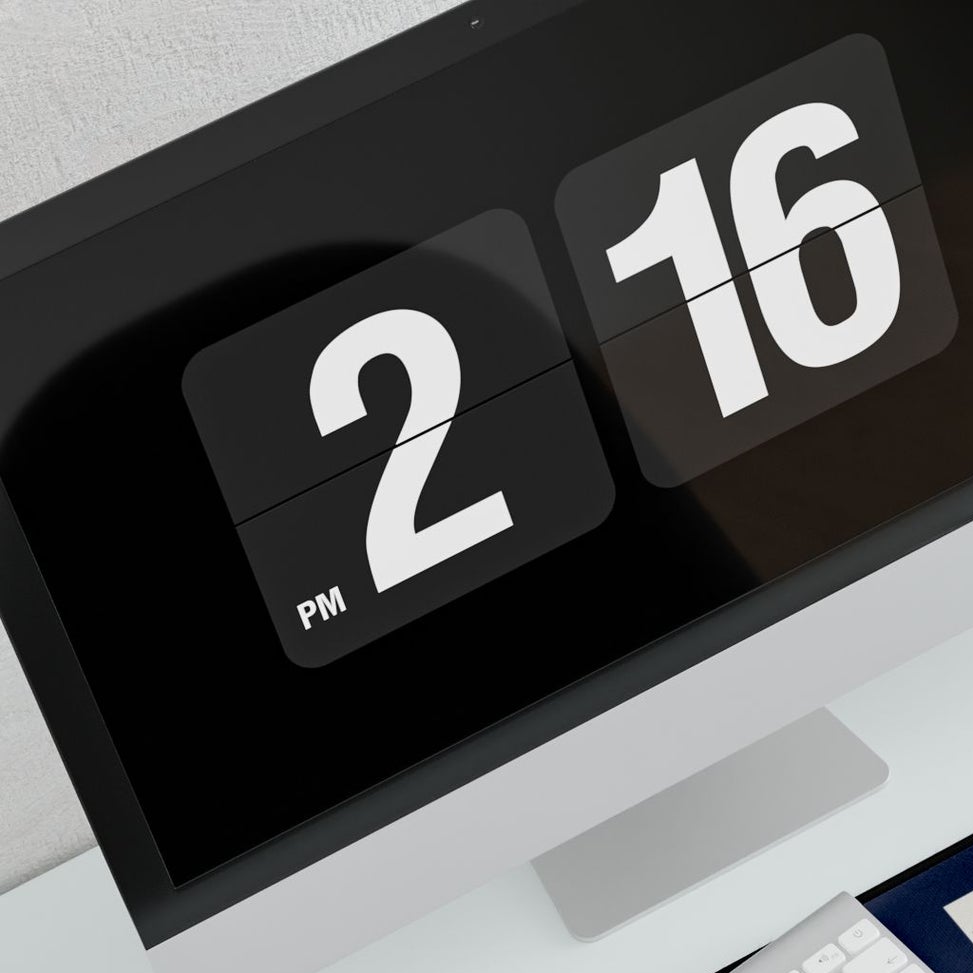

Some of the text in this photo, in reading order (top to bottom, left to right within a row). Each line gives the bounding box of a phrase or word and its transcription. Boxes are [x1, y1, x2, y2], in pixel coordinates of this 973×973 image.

[310, 103, 900, 593] 2 16
[297, 586, 346, 630] PM
